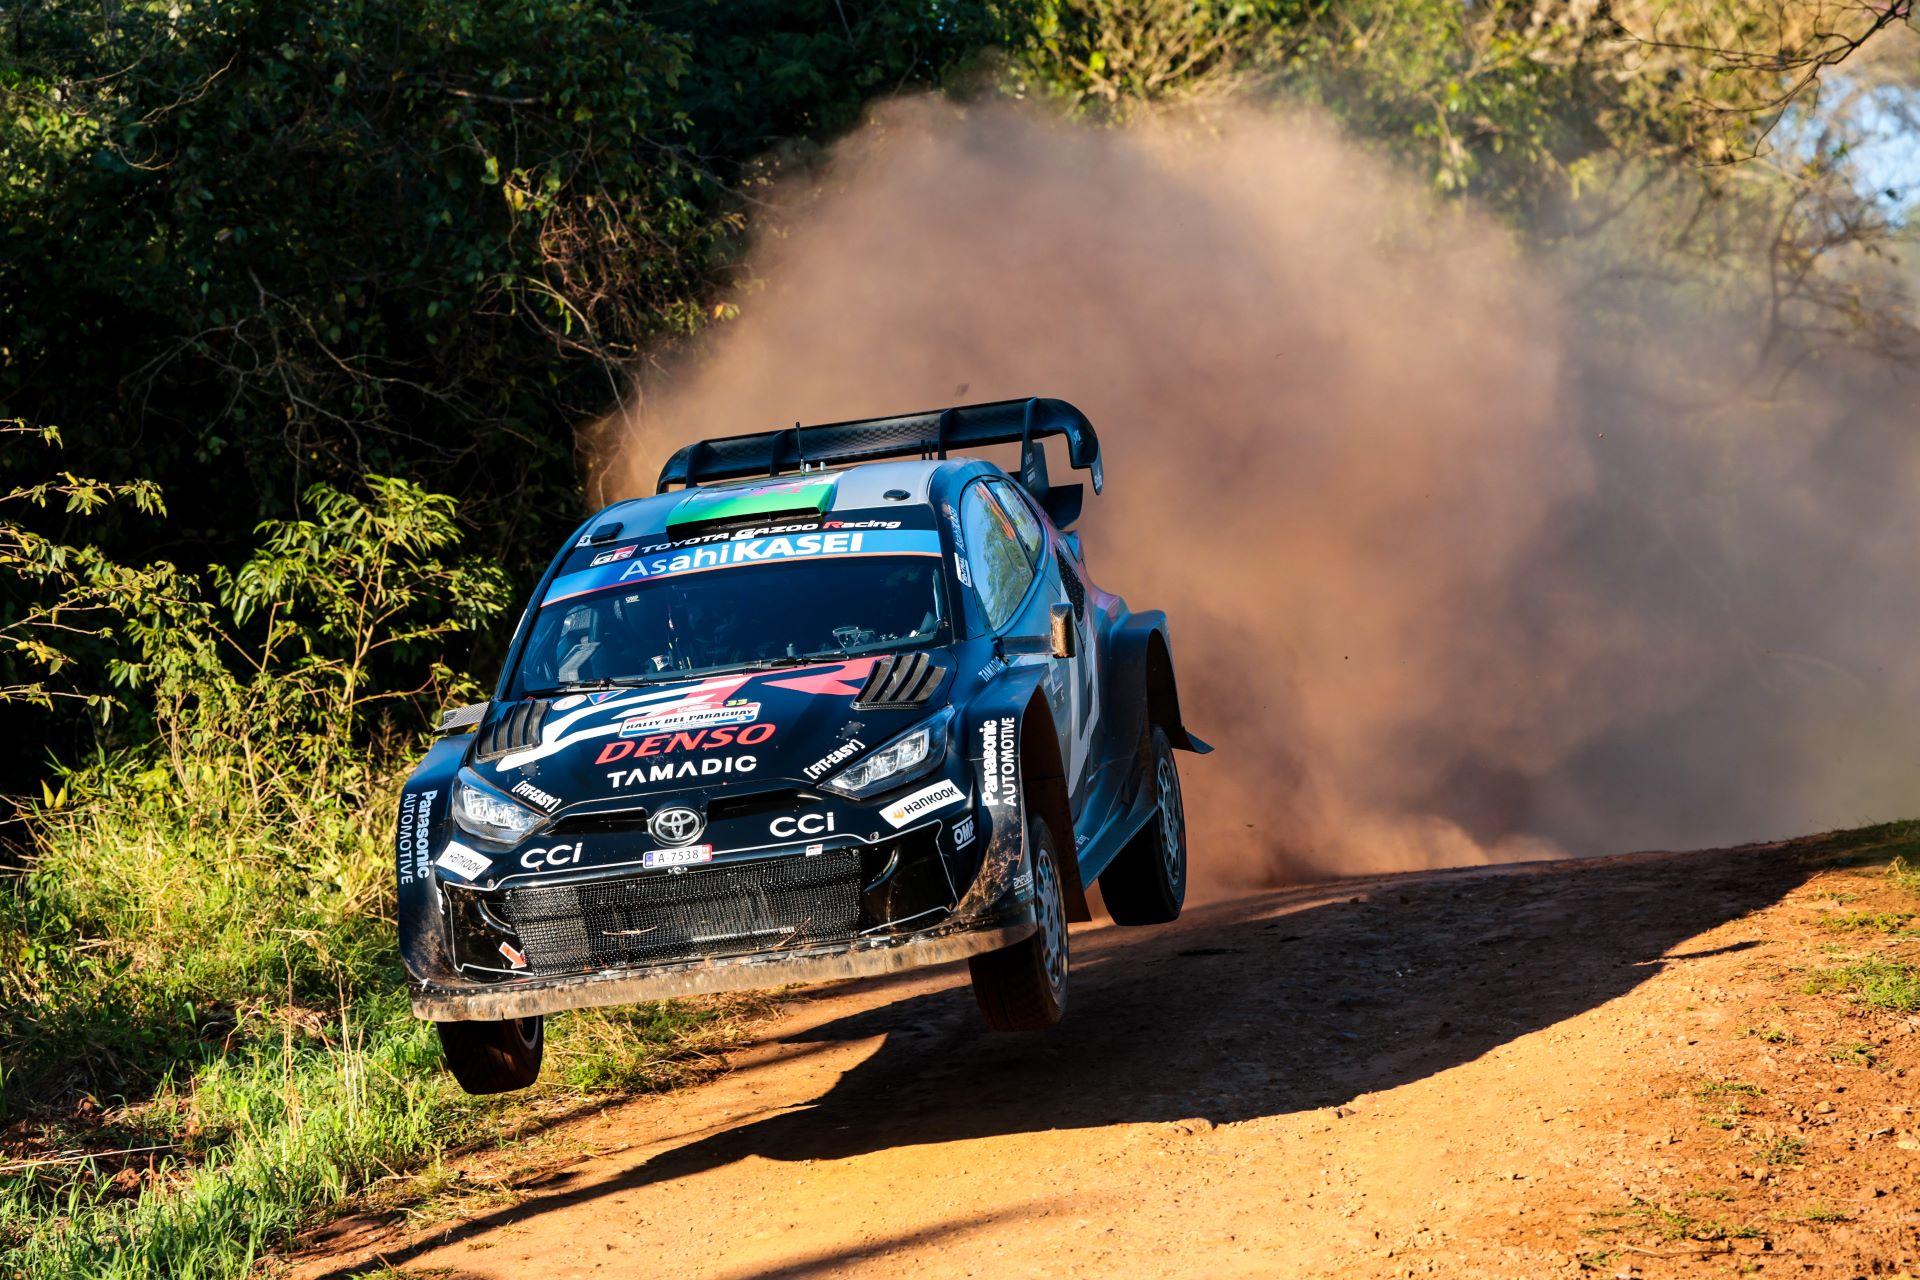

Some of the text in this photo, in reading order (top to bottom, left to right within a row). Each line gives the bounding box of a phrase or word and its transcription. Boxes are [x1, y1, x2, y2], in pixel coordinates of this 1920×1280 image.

[592, 546, 637, 565] GR
[641, 520, 901, 554] TOYOTA GAZOO Racing
[619, 533, 864, 581] AsahiKASEI
[626, 718, 662, 729] RALLY
[664, 716, 685, 725] DEL
[689, 709, 754, 721] PARAGUAY
[594, 723, 777, 765] DENSO
[979, 719, 999, 807] Panasonic
[1001, 717, 1017, 807] AUTOMOTIVE
[606, 755, 757, 788] TAMADIC
[400, 793, 418, 885] AUTOMOTIVE
[416, 789, 438, 879] Panasonic
[953, 821, 975, 845] OMP
[671, 850, 699, 861] 7538
